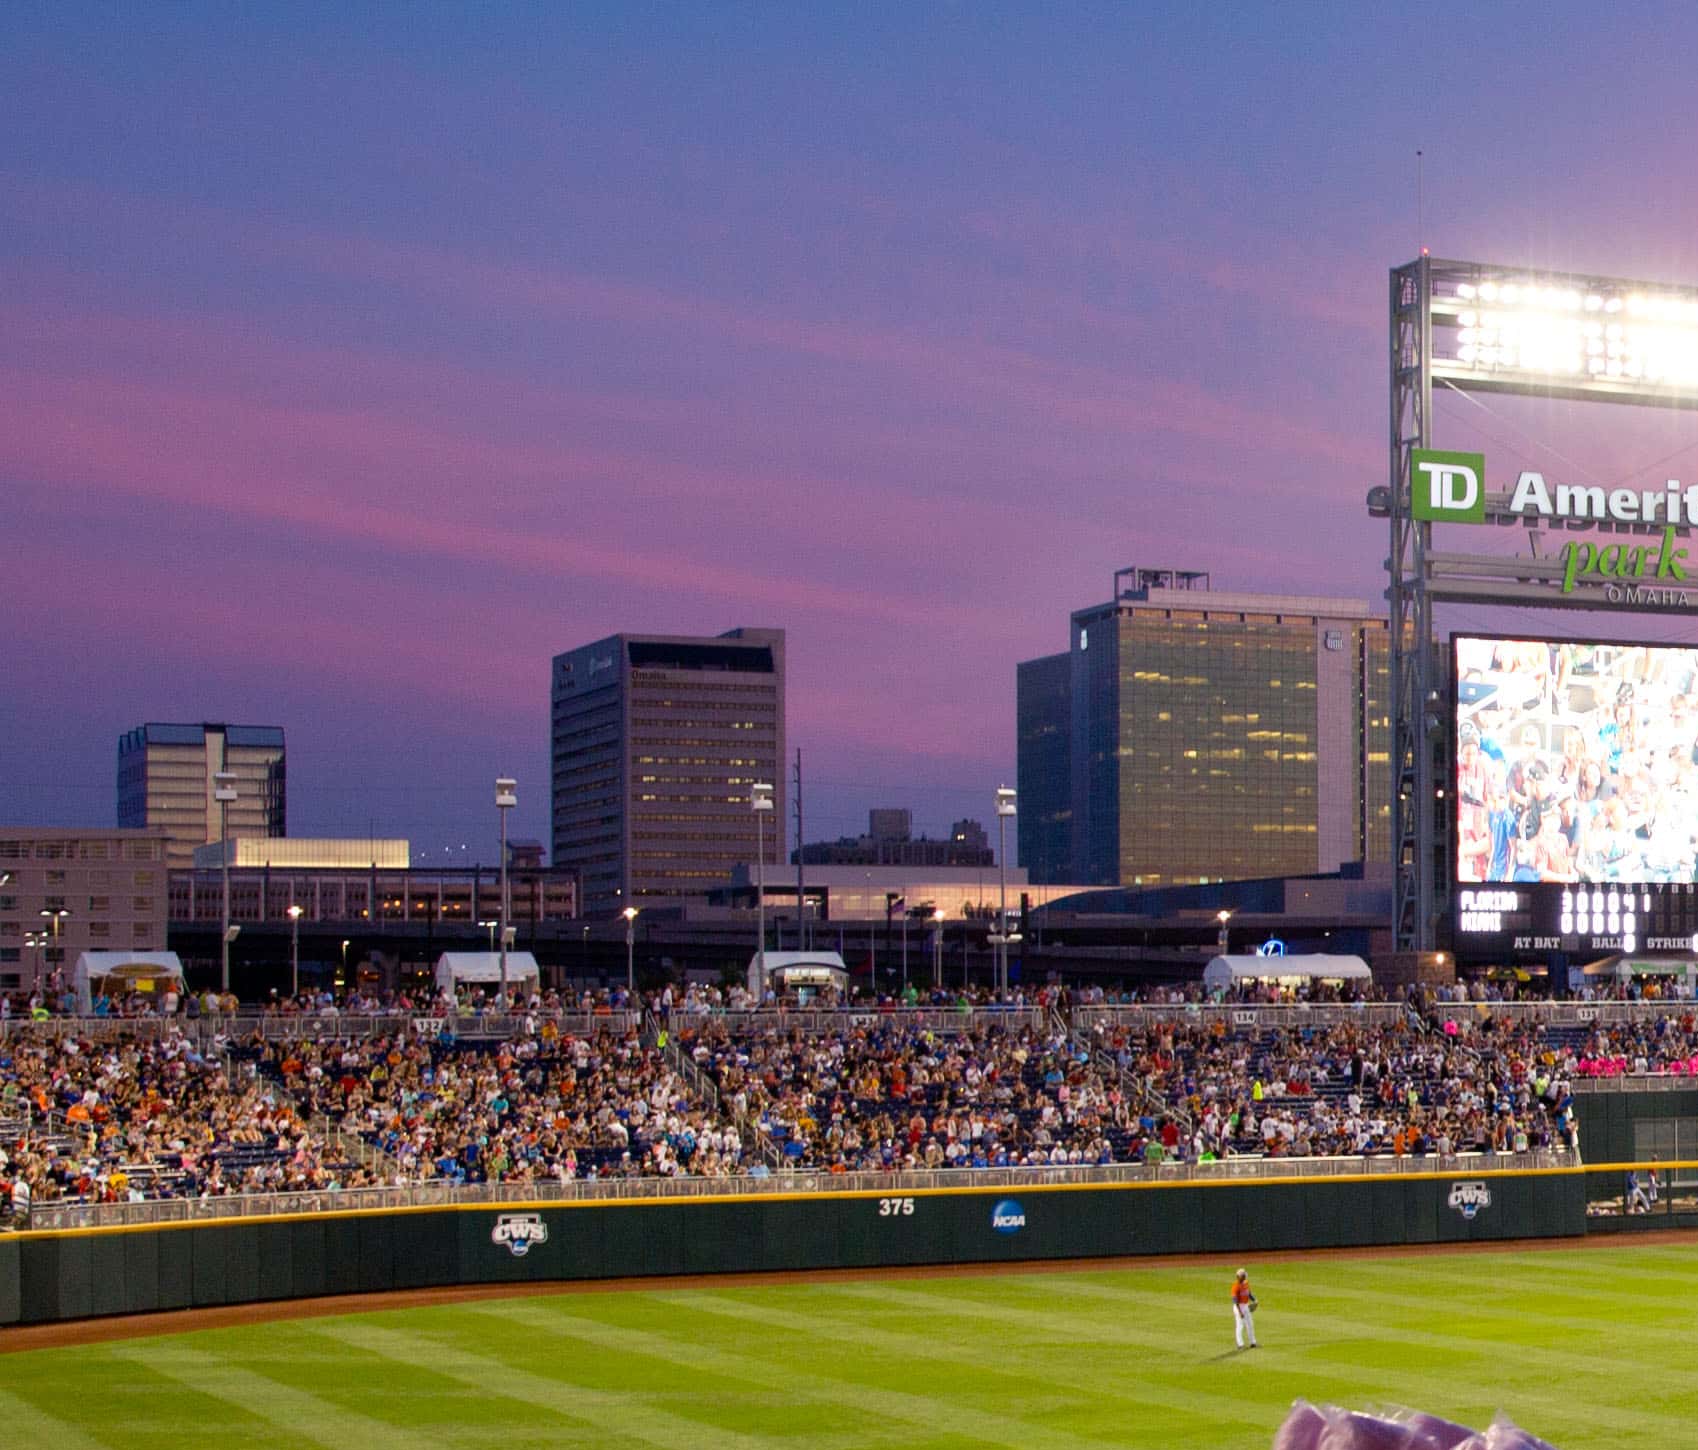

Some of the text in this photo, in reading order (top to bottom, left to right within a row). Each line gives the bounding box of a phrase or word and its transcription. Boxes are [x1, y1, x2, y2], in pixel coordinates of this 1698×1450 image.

[1419, 462, 1478, 510] TD
[1562, 525, 1688, 593] park
[1608, 586, 1689, 606] OMAHA
[1461, 891, 1518, 911] FLORIDA
[1461, 912, 1501, 931] MIAMI
[1513, 937, 1531, 949] AT
[1534, 937, 1560, 949] BAT
[879, 1198, 914, 1216] 375
[992, 1215, 1025, 1227] NCAA
[493, 1222, 547, 1242] CWS
